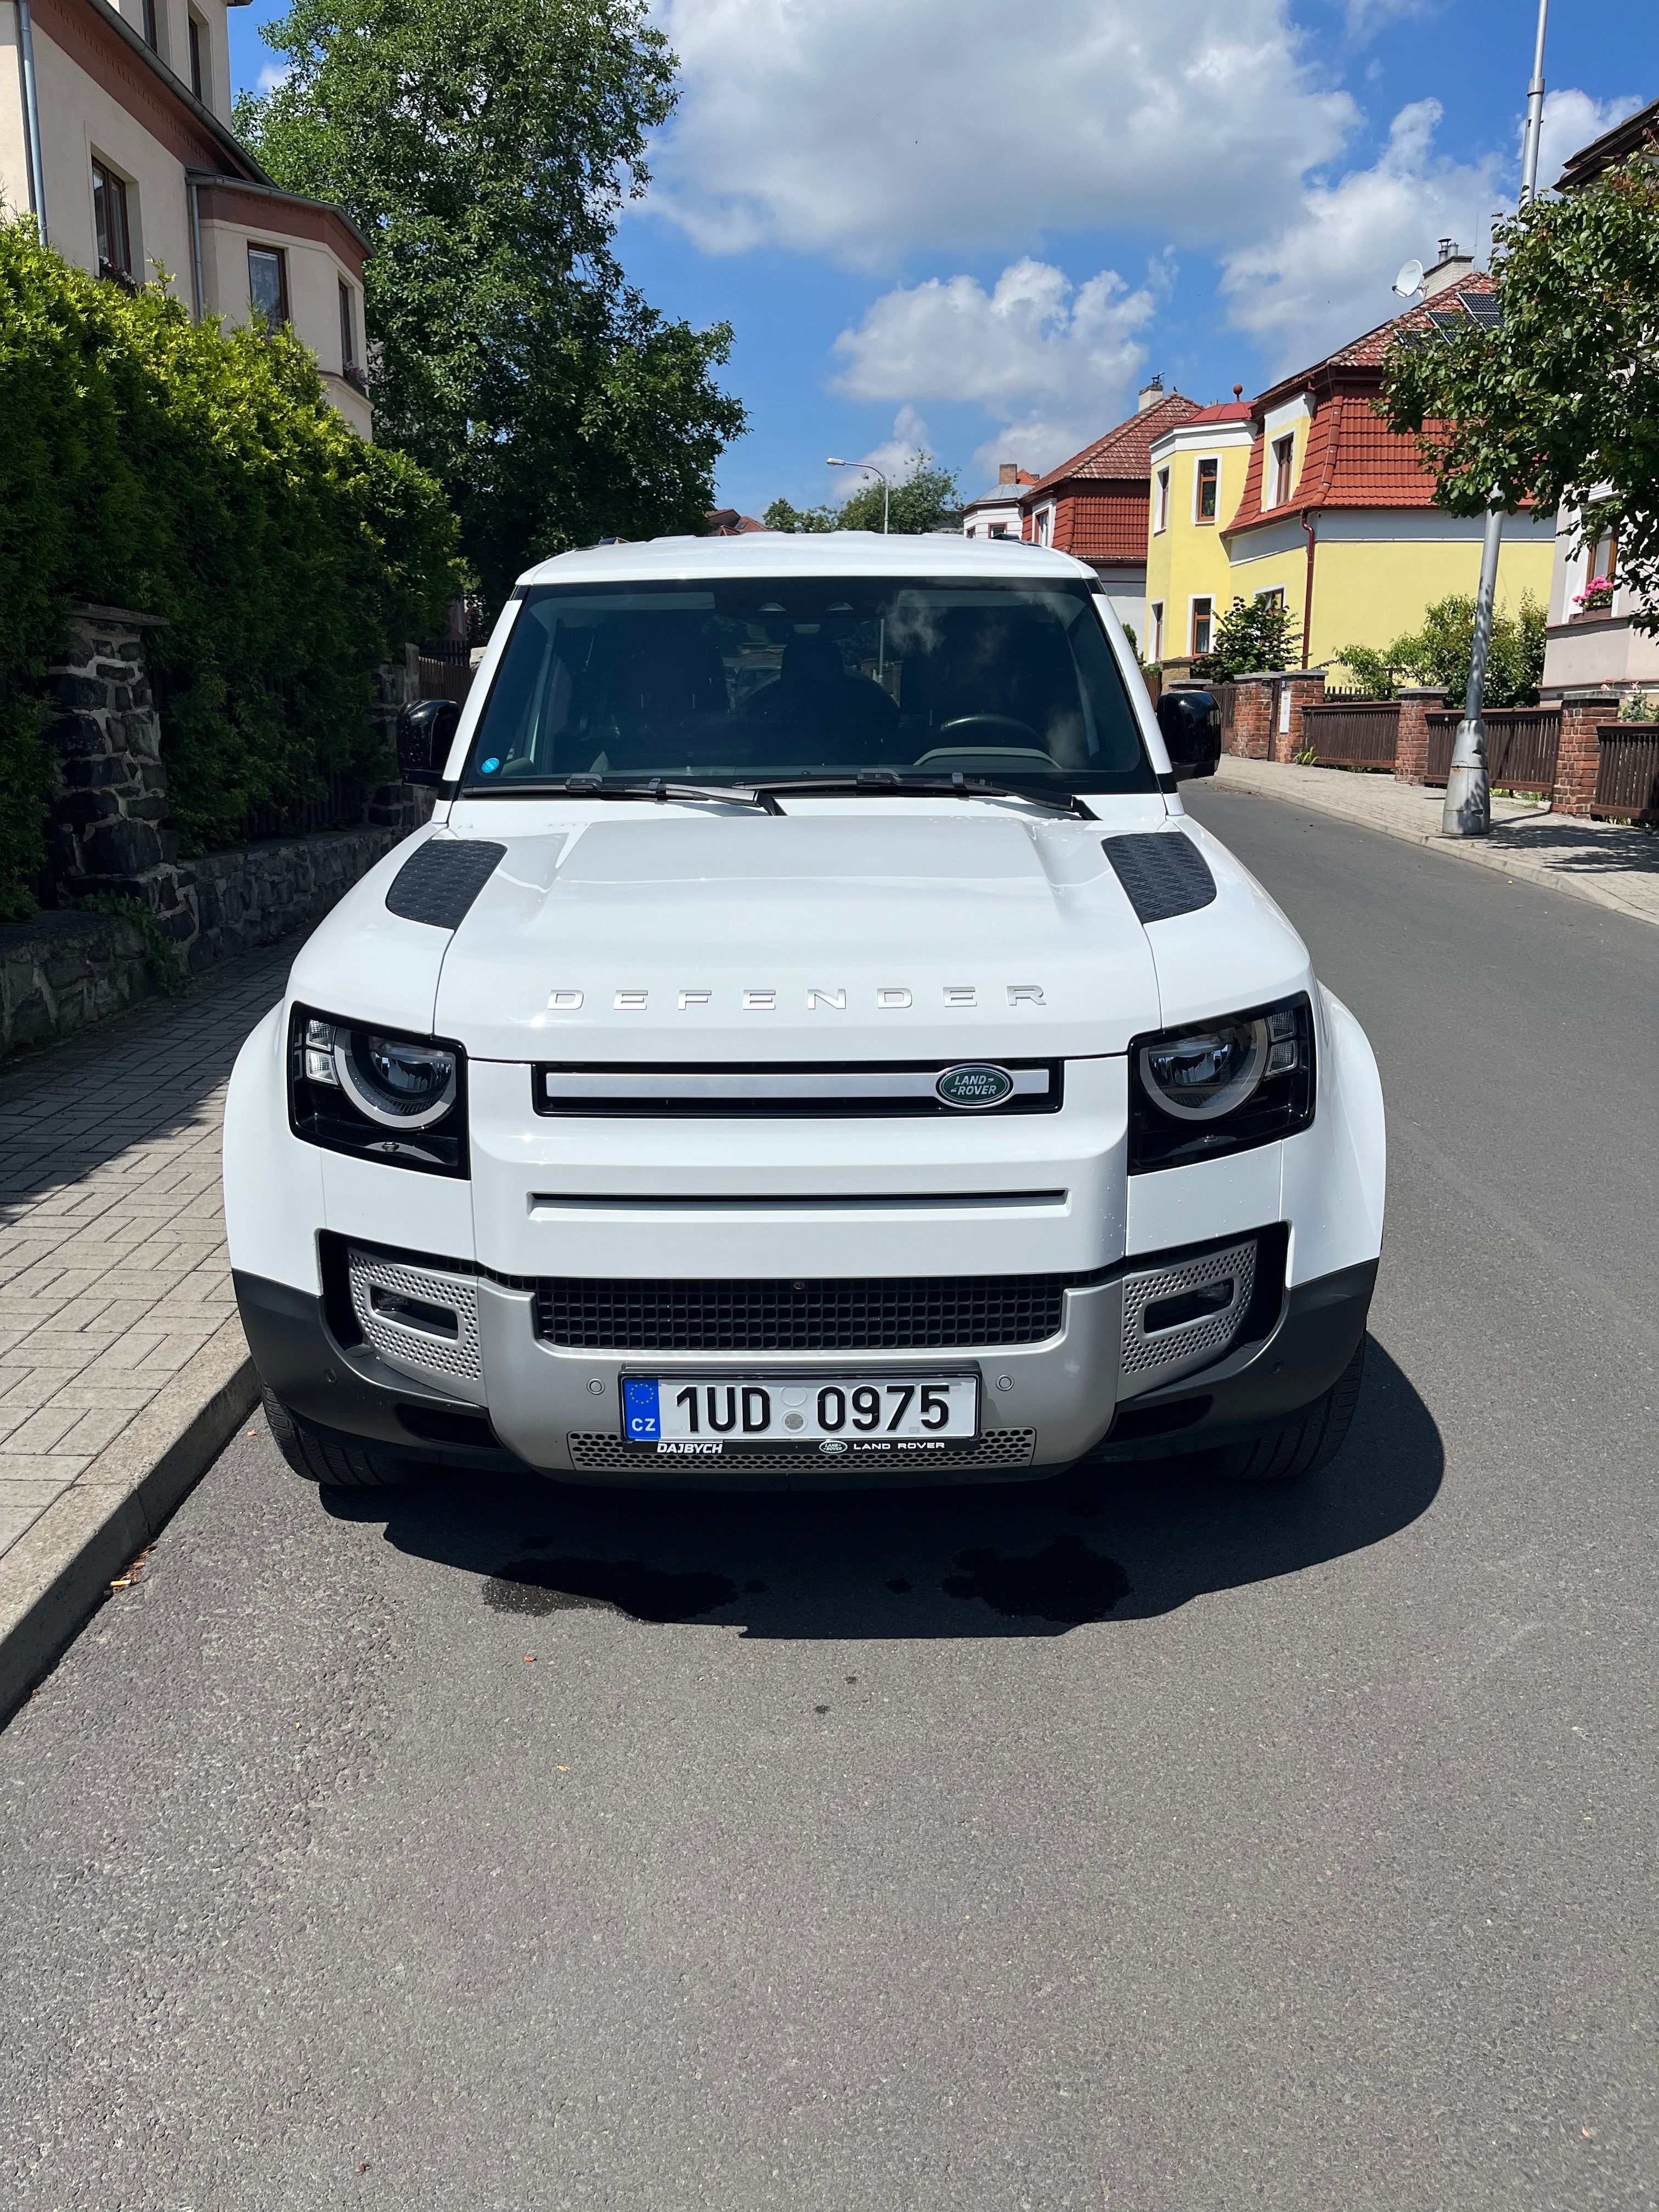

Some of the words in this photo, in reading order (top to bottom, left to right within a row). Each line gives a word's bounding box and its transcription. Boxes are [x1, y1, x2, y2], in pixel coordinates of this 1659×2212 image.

[548, 985, 1047, 1011] DEFENDER
[955, 1075, 987, 1086] LAND
[957, 1085, 997, 1096] ROVER
[676, 1385, 771, 1433] 1UD
[817, 1384, 950, 1431] 0975
[631, 1418, 656, 1431] CZ
[657, 1443, 723, 1454] DAJBYCH
